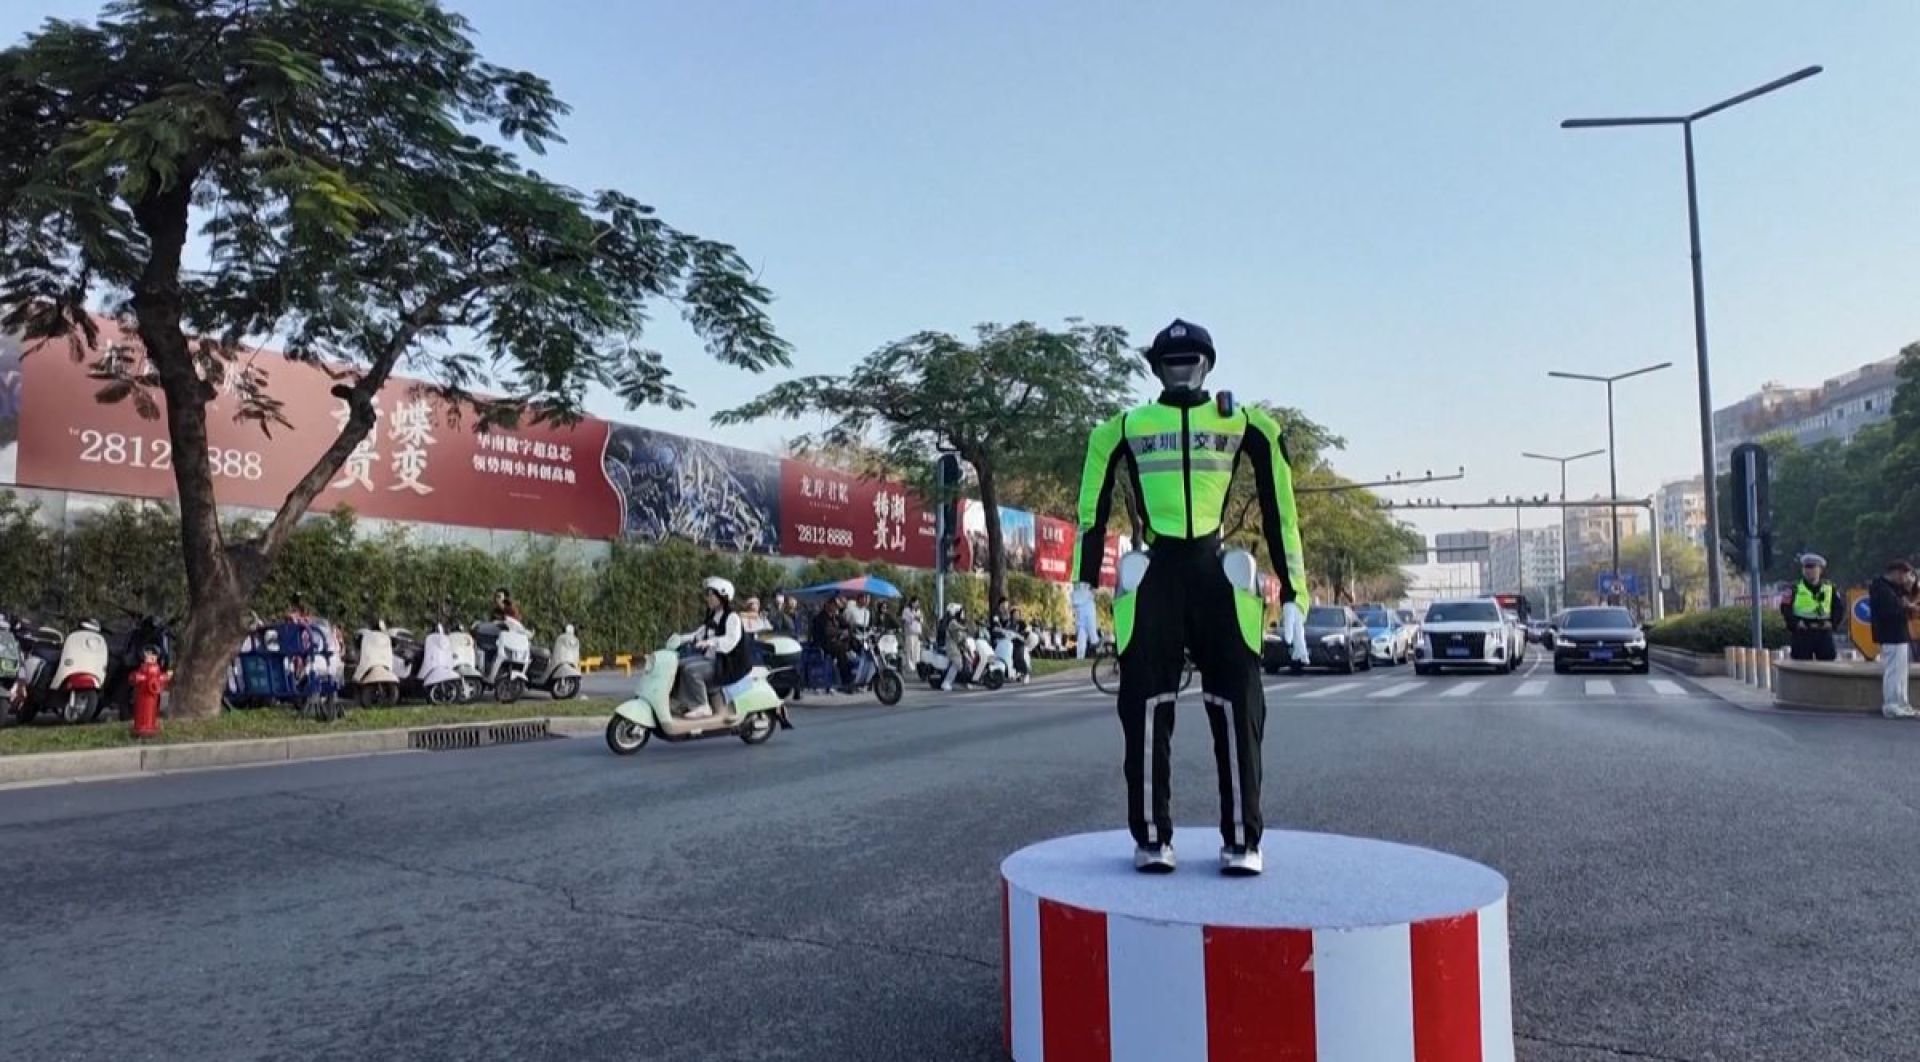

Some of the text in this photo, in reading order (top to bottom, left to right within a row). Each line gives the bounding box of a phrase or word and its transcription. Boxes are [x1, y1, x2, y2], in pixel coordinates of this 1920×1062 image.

[79, 429, 172, 470] 2812
[388, 400, 437, 495] 蝶变
[798, 524, 853, 548] 2812 8888
